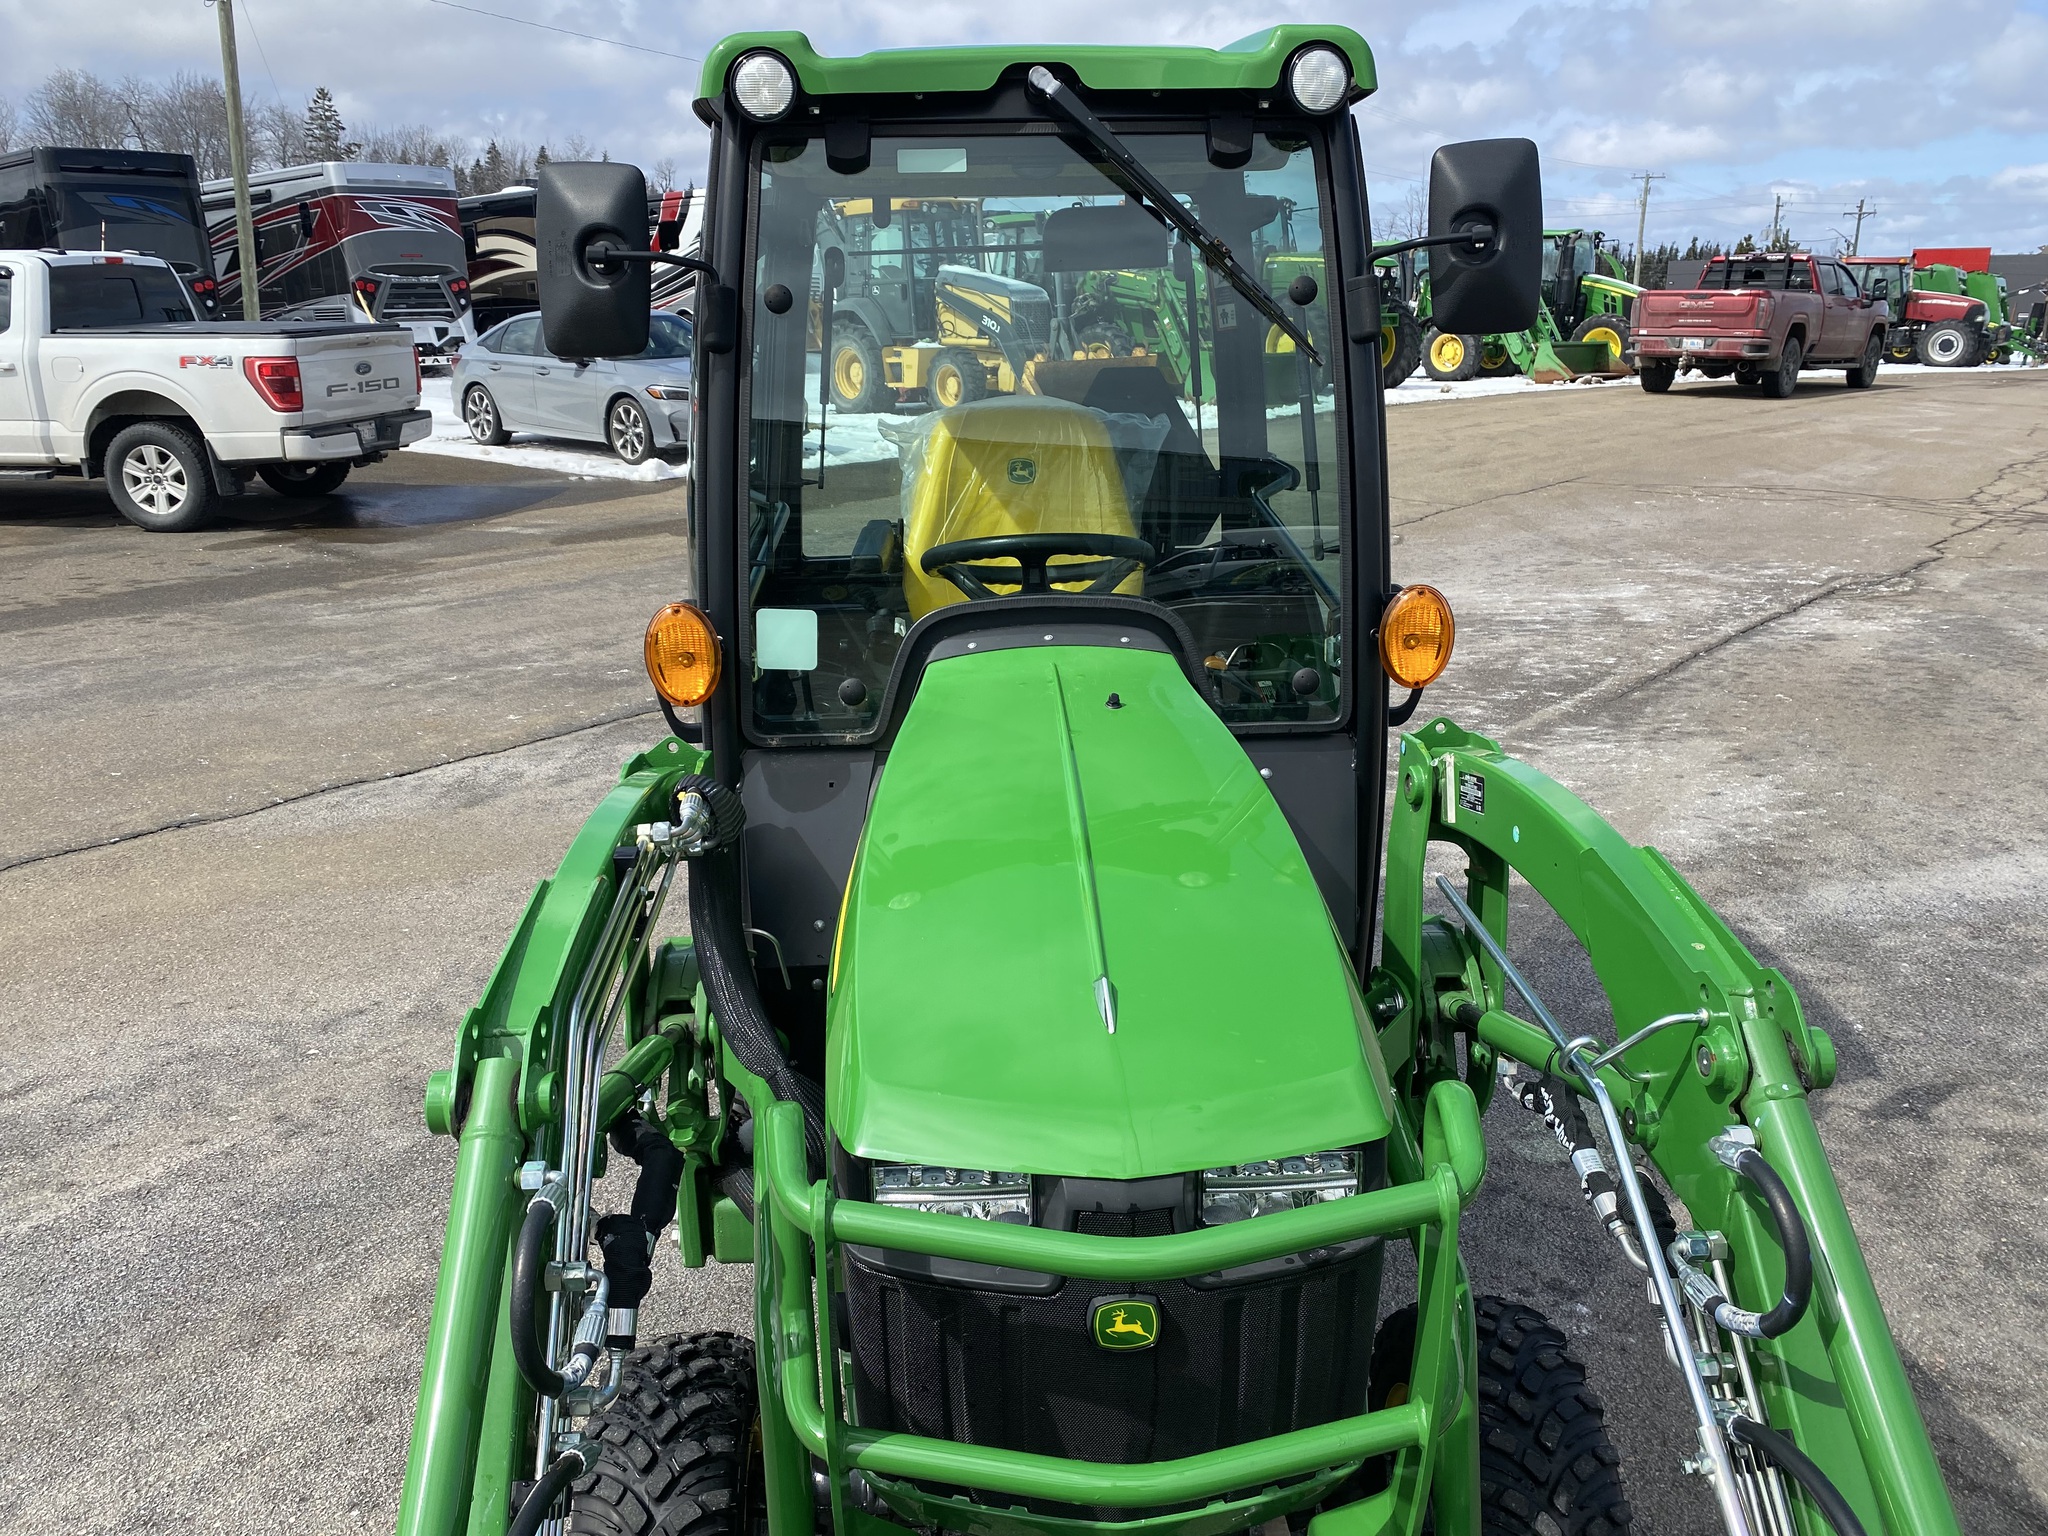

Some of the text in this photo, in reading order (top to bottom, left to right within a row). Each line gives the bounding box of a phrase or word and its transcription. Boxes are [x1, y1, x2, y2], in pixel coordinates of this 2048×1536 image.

[1679, 301, 1715, 309] GMC
[981, 315, 1000, 333] 310J
[179, 355, 233, 369] FX4
[326, 377, 400, 398] F-150
